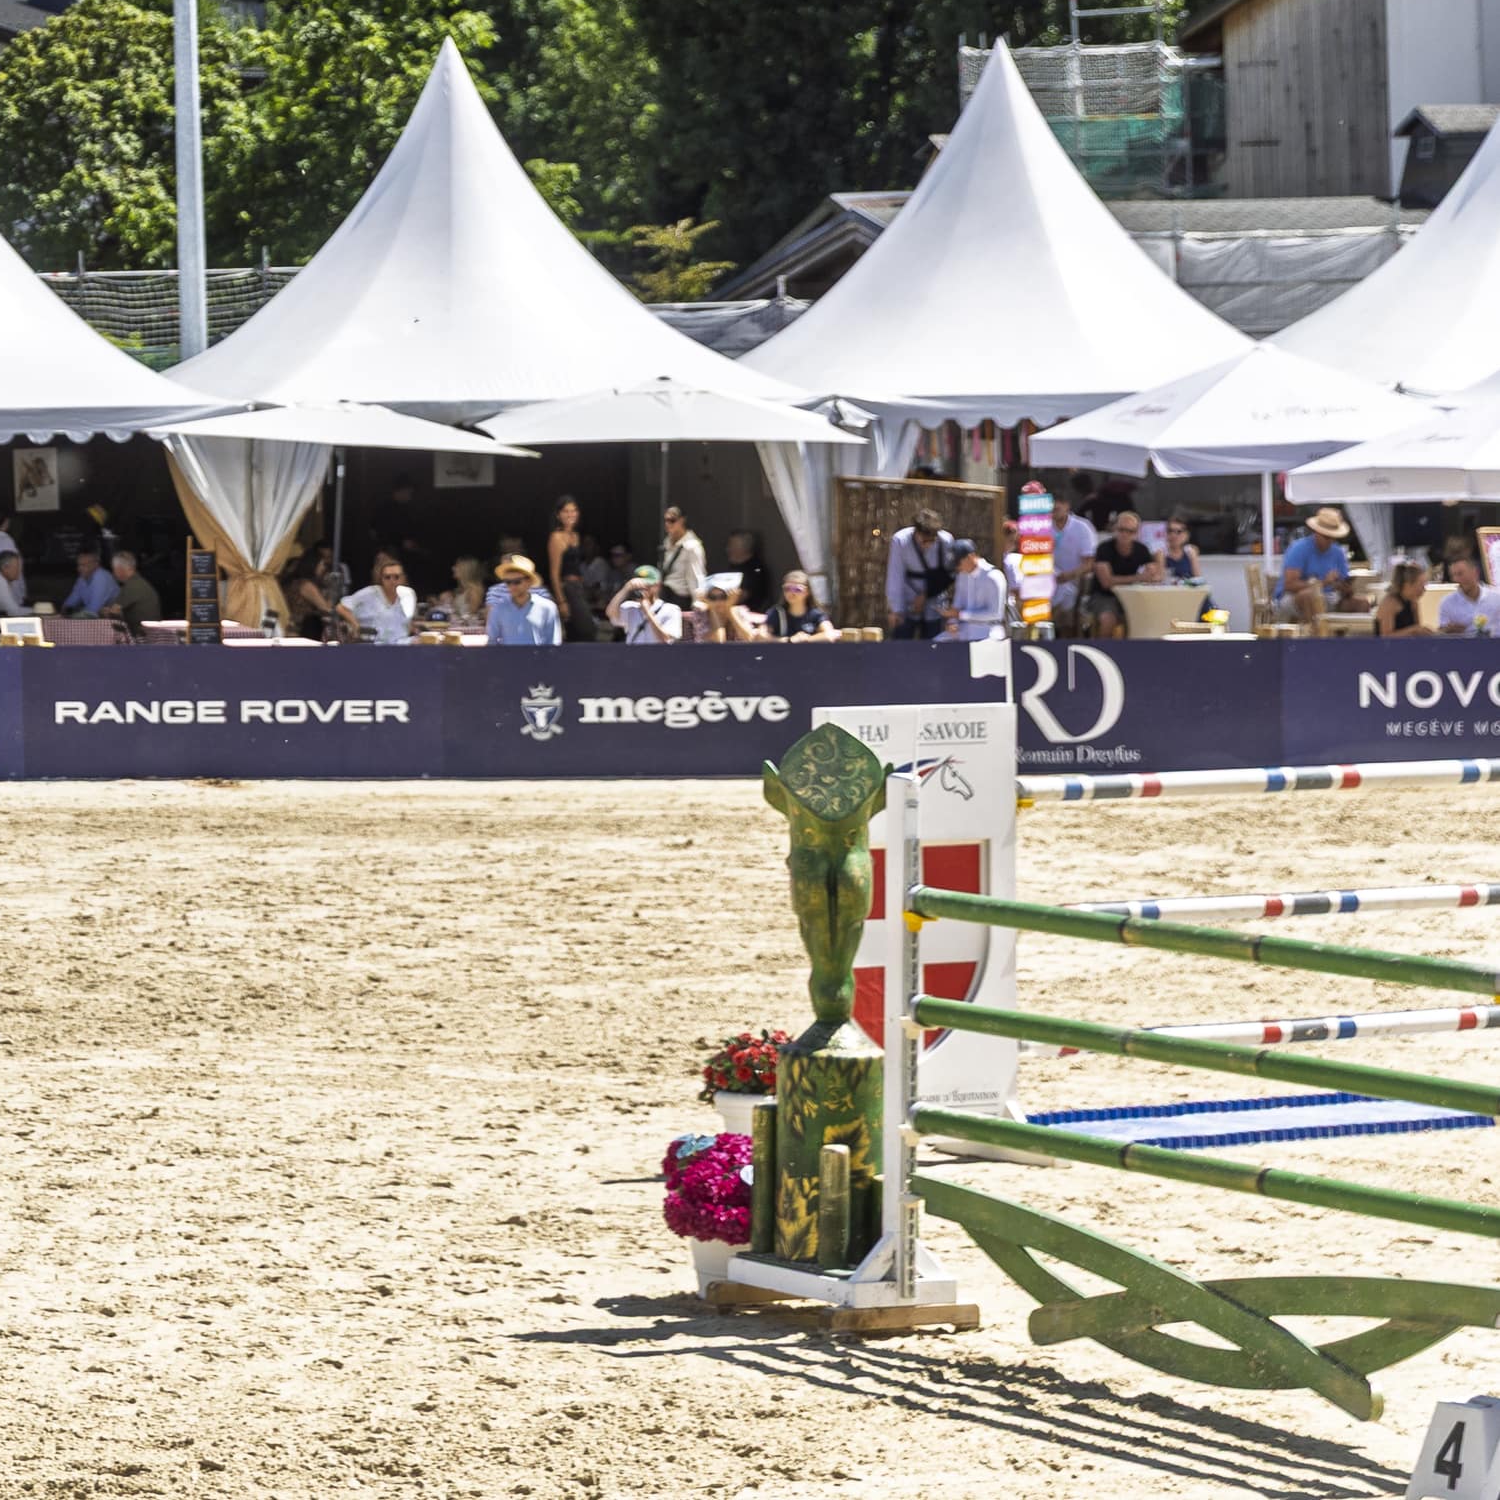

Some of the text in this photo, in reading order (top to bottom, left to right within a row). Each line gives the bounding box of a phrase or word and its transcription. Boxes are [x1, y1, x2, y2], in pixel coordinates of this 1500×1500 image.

[54, 699, 410, 724] RANGE ROVER
[578, 690, 791, 729] megève
[1385, 719, 1465, 737] MEGÈVE
[1076, 744, 1141, 768] Dreyfus
[1433, 1421, 1465, 1491] 4
